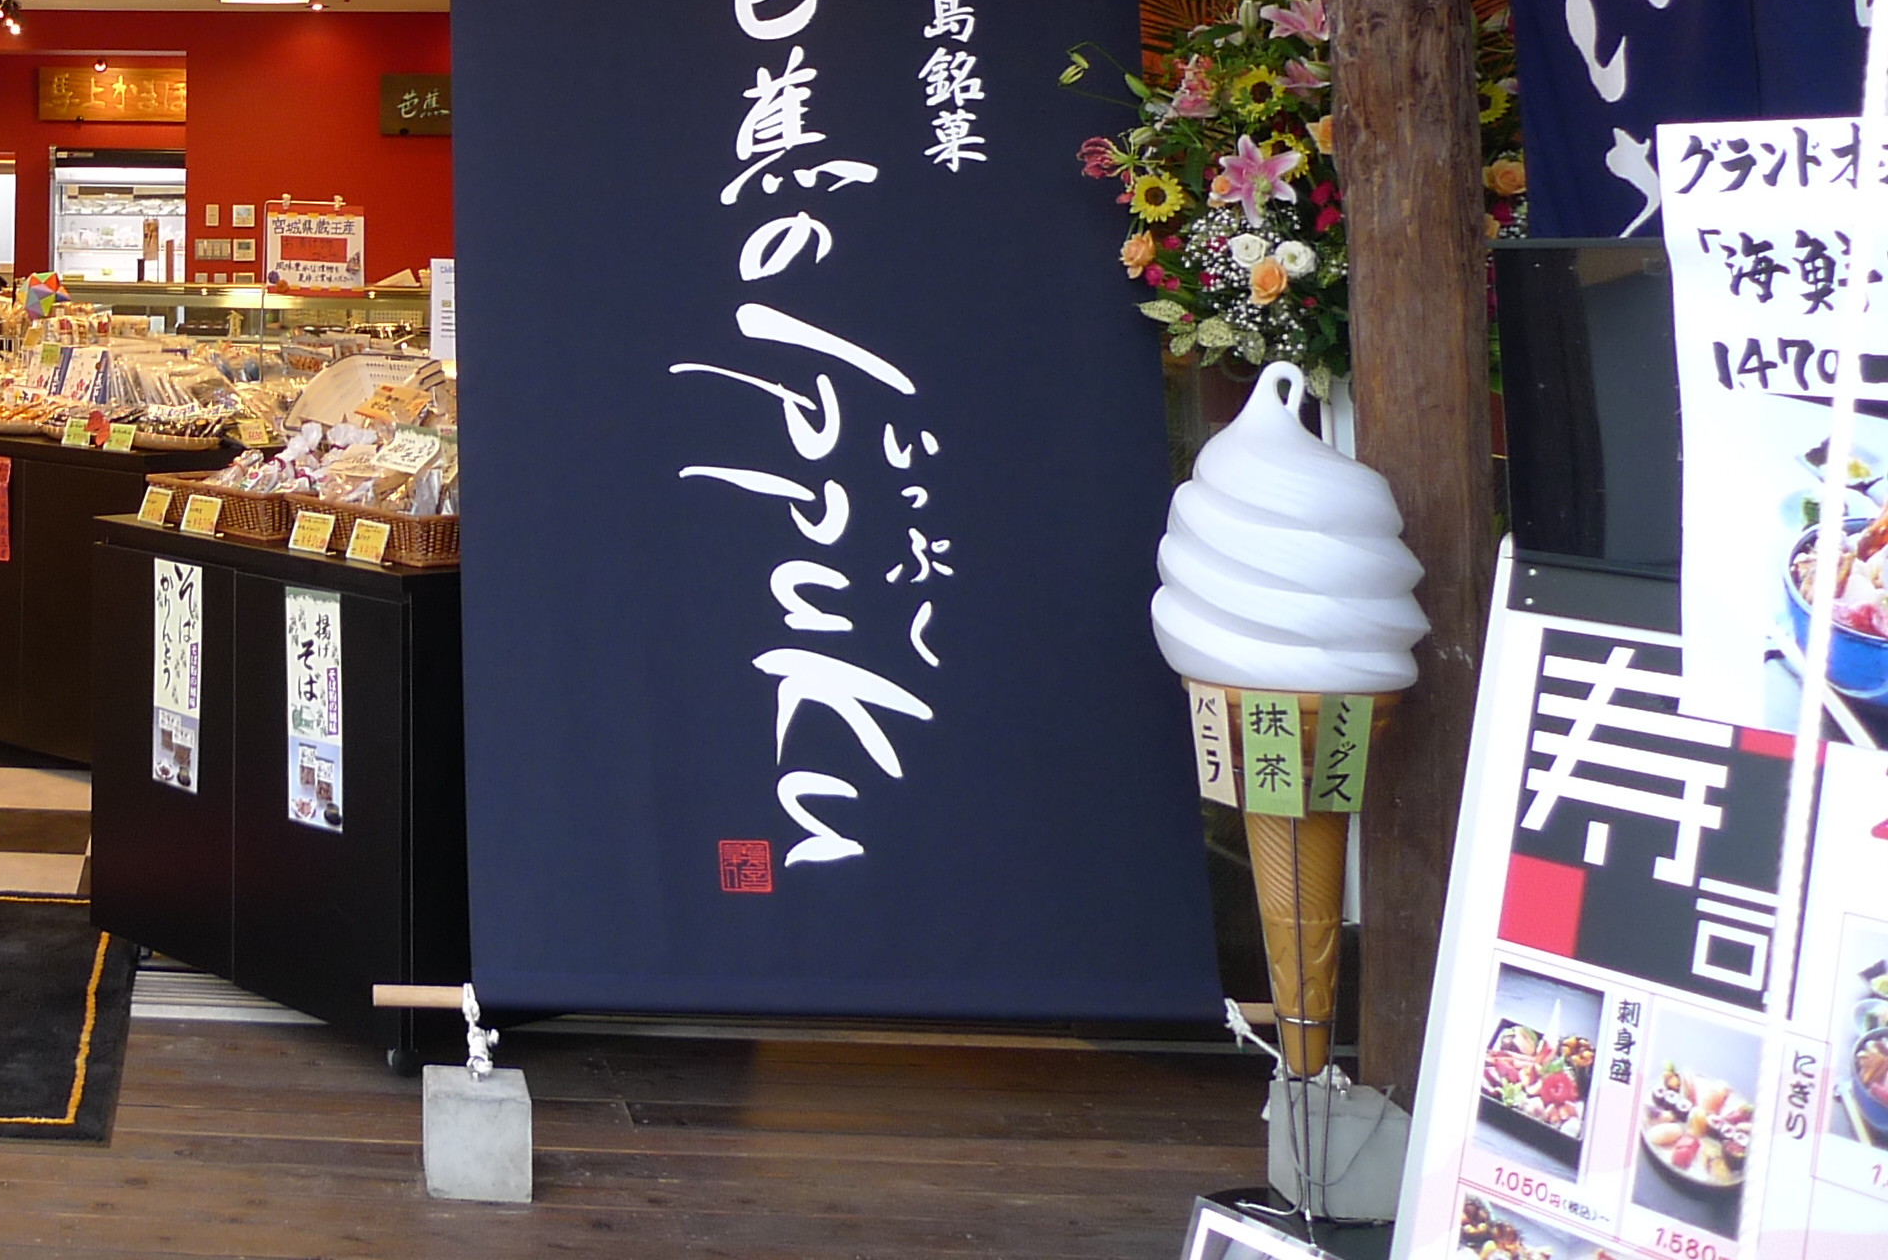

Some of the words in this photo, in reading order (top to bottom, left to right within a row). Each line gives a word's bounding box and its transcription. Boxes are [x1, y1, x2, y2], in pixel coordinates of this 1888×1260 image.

[396, 89, 450, 119] 芭蕉
[882, 422, 954, 668] いっぷく
[297, 639, 323, 702] そば
[1197, 696, 1221, 783] バニラ
[1248, 702, 1296, 793] 抹茶
[1608, 998, 1642, 1086] 刺身盛
